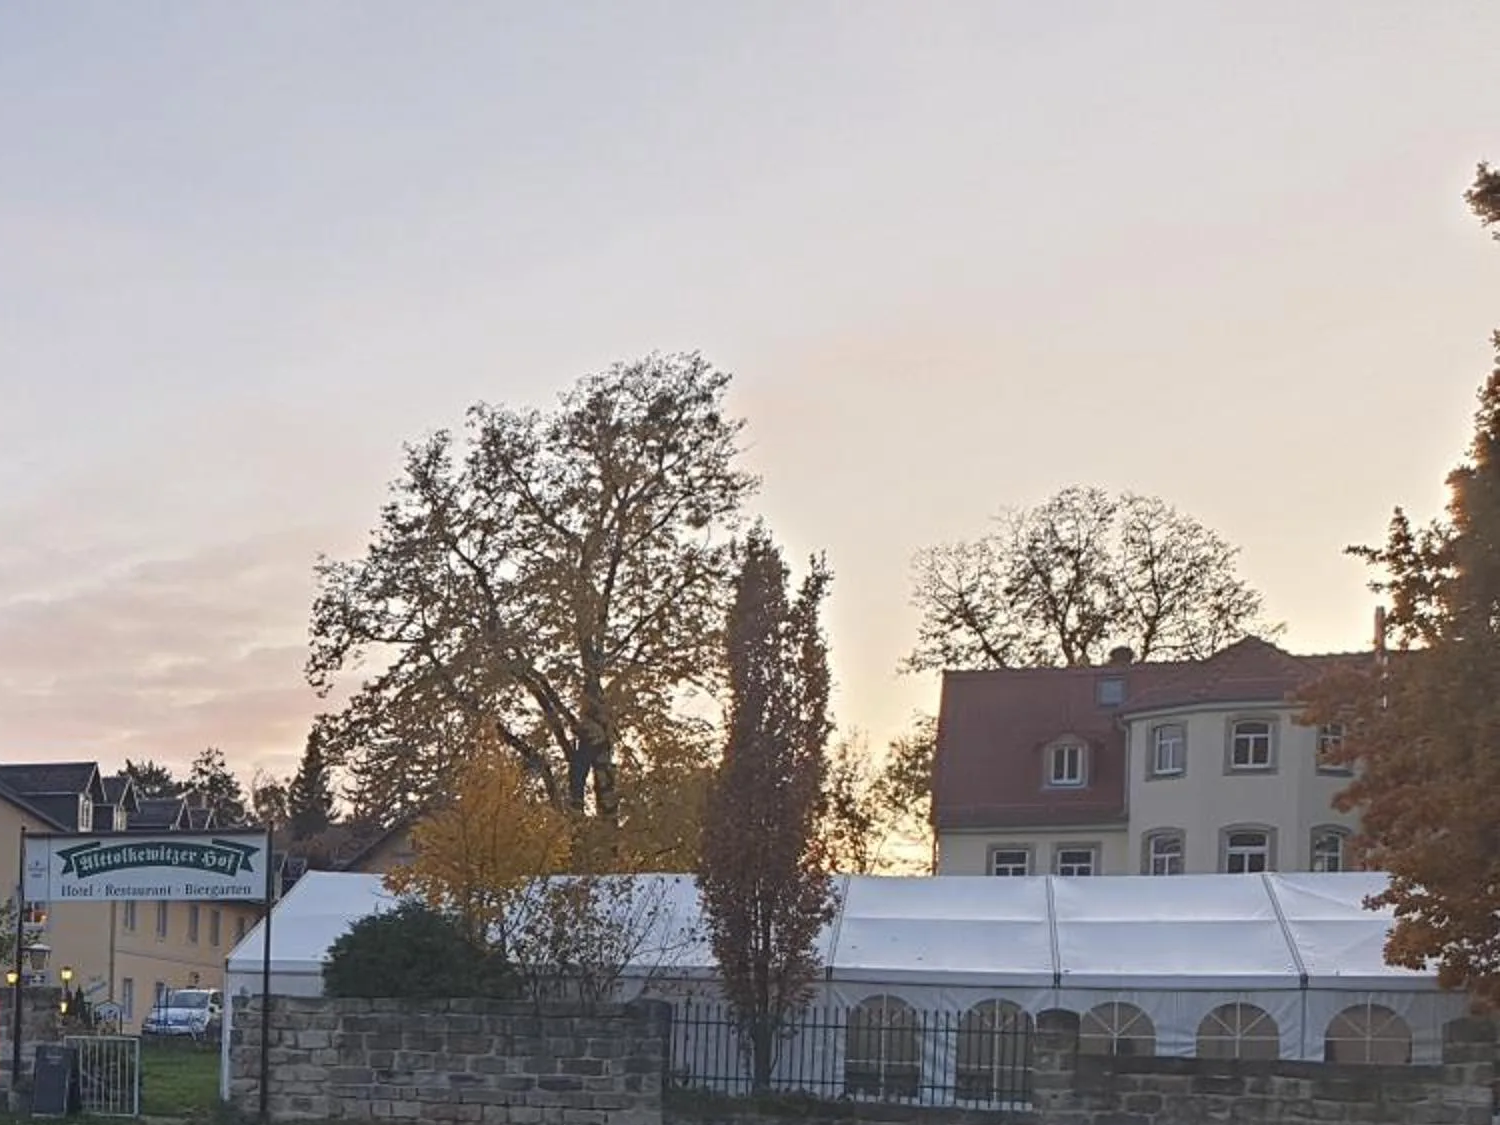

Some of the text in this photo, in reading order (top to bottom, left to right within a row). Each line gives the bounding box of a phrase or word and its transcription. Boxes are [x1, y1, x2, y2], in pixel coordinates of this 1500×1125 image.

[201, 850, 236, 872] Hof
[61, 883, 252, 898] Hotel Restaurant Biergarten
